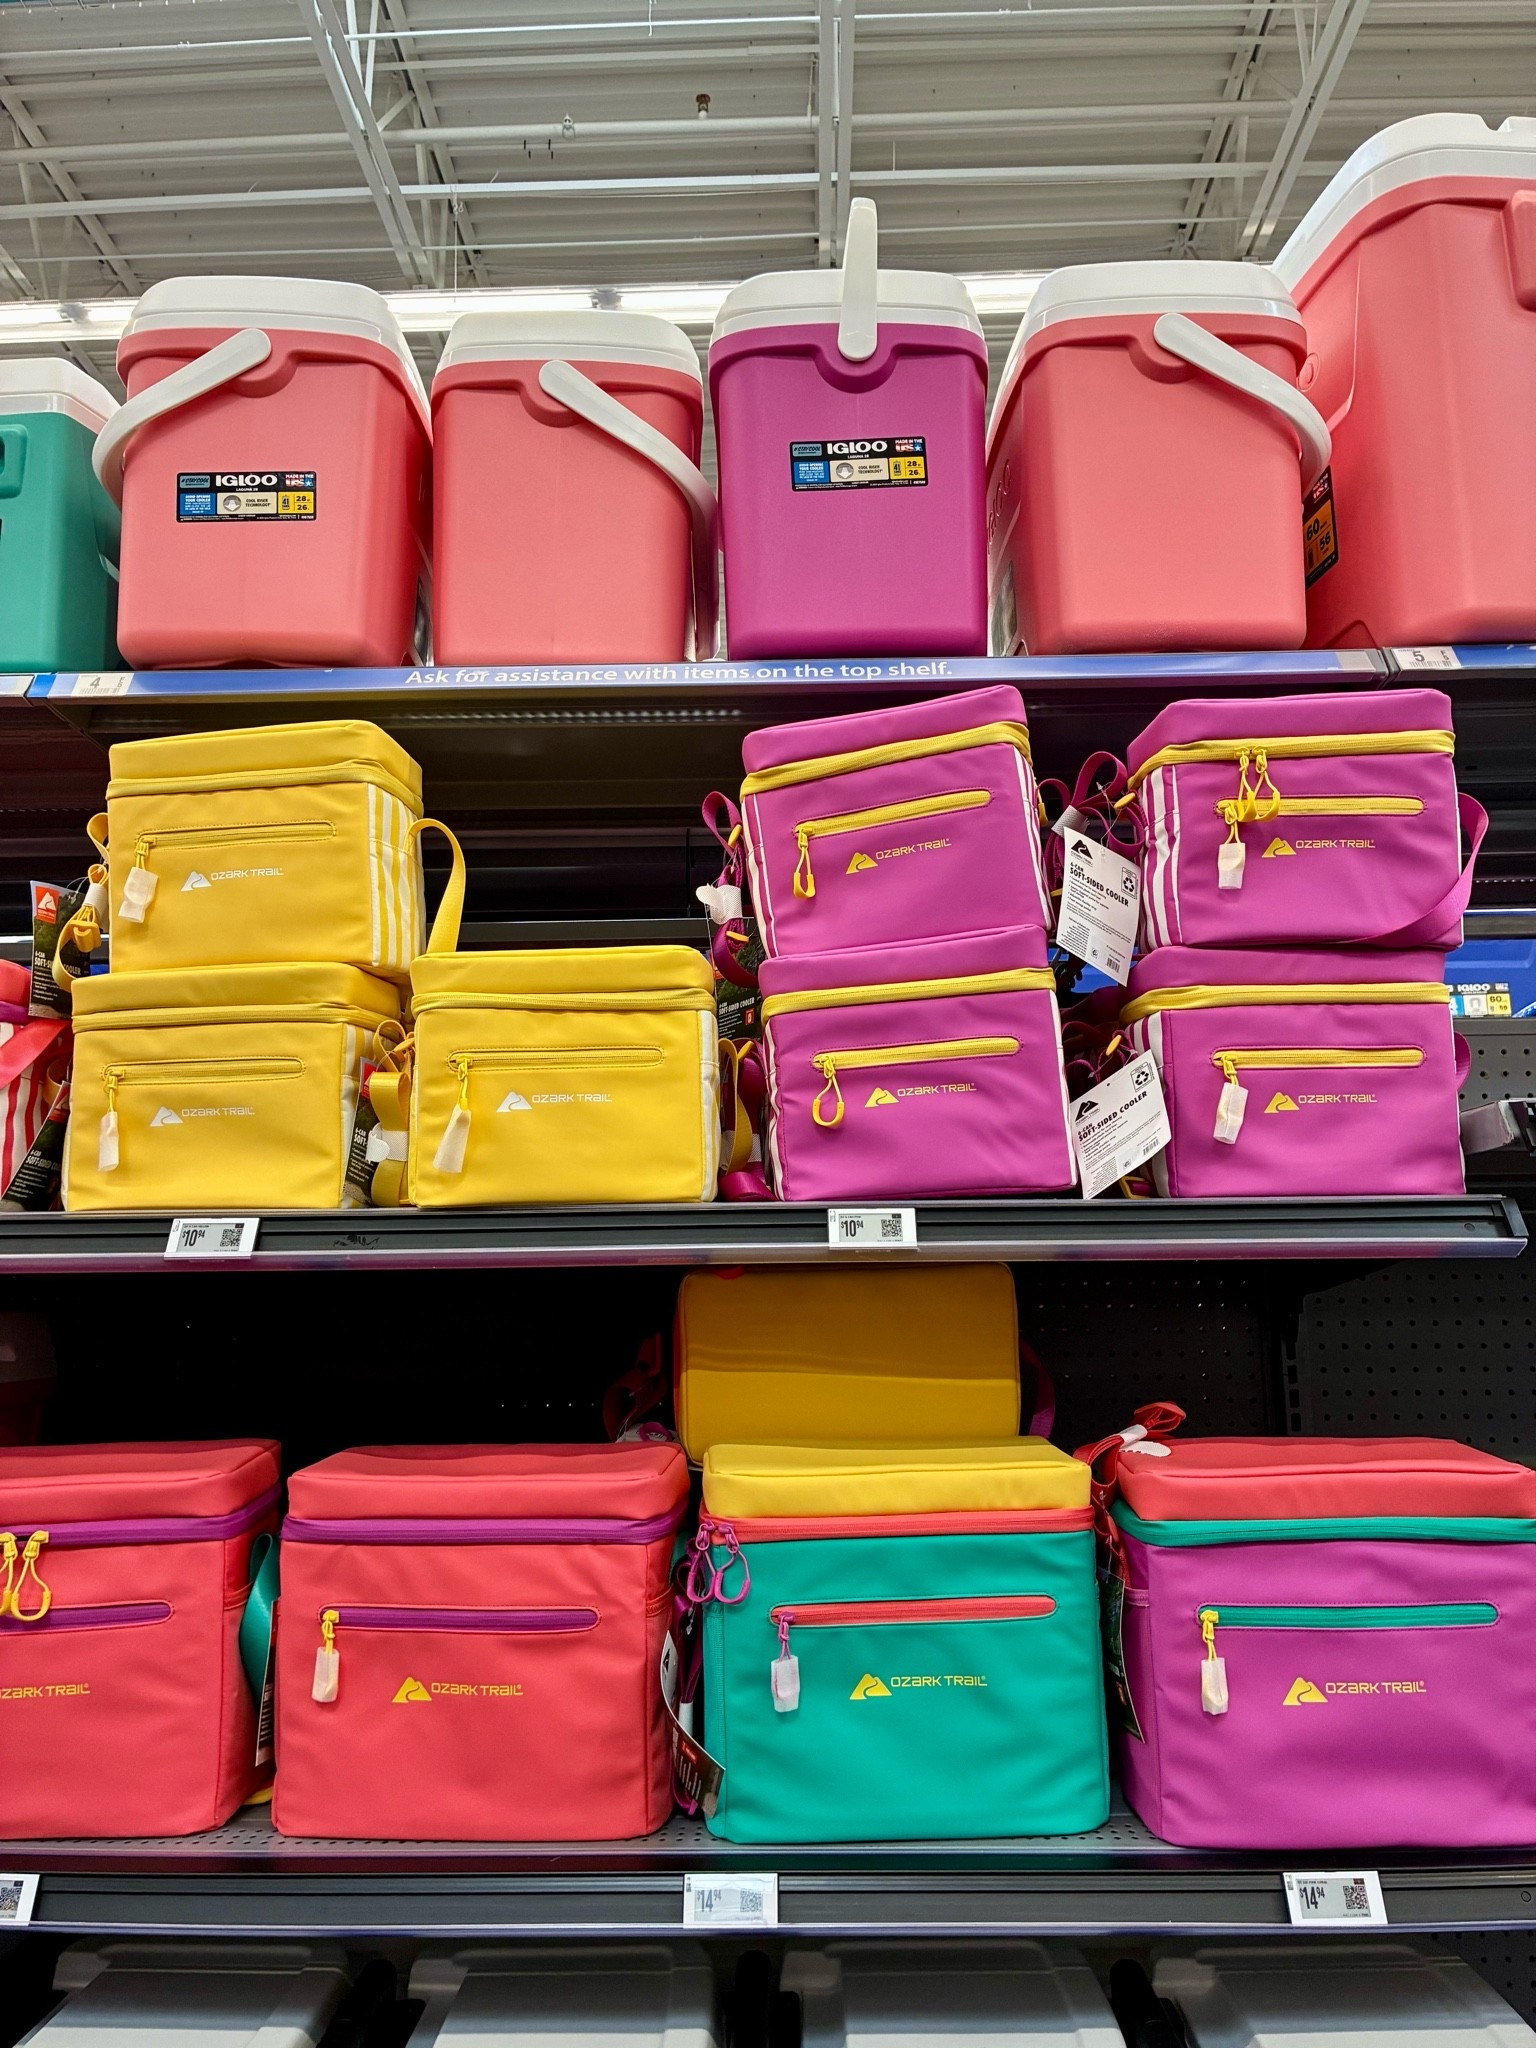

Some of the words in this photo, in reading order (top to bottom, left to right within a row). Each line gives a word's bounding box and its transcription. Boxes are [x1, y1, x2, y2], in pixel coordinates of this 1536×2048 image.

[827, 441, 887, 454] IGLOO
[216, 475, 277, 486] IGLOO
[1306, 518, 1319, 541] 60
[1413, 651, 1425, 662] 5
[406, 670, 449, 684] Ask
[455, 669, 490, 683] for
[495, 668, 617, 682] assistance
[624, 666, 676, 680] with
[684, 665, 748, 679] items
[752, 666, 787, 679] on
[794, 663, 834, 678] the
[840, 663, 881, 679] top
[888, 662, 952, 676] shelf.
[90, 677, 100, 688] 4
[876, 845, 916, 859] OZARK
[917, 839, 951, 851] TRAIL
[1296, 840, 1337, 848] OZARK
[1339, 840, 1375, 848] TRAIL
[211, 870, 248, 880] OZARK
[250, 867, 284, 877] TRAIL
[1070, 867, 1104, 891] SOFT-SIDED
[1106, 888, 1129, 907] COOLER
[1458, 983, 1490, 992] IGLOO
[719, 1003, 739, 1015] SOFT-SIDED
[740, 997, 755, 1008] COOLER
[897, 1086, 939, 1096] OZARK
[940, 1083, 976, 1093] TRAIL
[532, 1094, 574, 1103] OZARK
[577, 1094, 612, 1102] TRAIL
[1298, 1095, 1341, 1103] OZARK
[1343, 1094, 1377, 1102] TRAIL
[182, 1108, 220, 1116] OZARK
[222, 1107, 255, 1115] TRAIL
[1079, 1112, 1118, 1142] SOFT-SIDED
[1119, 1090, 1147, 1113] COOLER
[1078, 1123, 1093, 1135] 6-CAN
[26, 1156, 52, 1169] SOFT-SIDED
[891, 1676, 941, 1687] OZARK
[944, 1676, 988, 1686] TRAIL
[1325, 1682, 1380, 1694] OZARK
[1381, 1681, 1426, 1693] TRAIL
[0, 1686, 43, 1699] ZARK
[45, 1683, 90, 1696] TRAIL
[431, 1683, 478, 1695] OZARK
[480, 1684, 523, 1696] TRAIL
